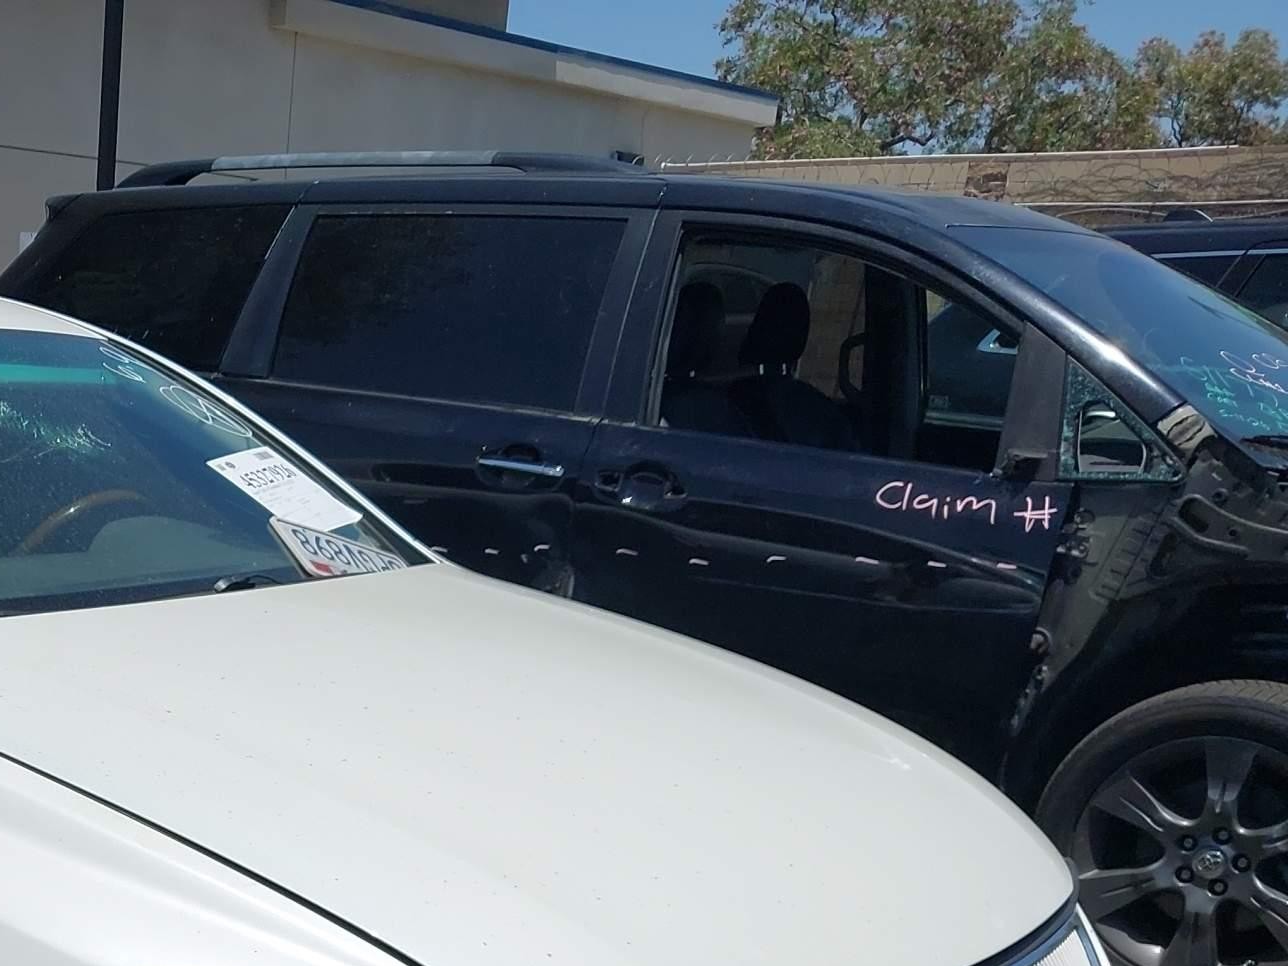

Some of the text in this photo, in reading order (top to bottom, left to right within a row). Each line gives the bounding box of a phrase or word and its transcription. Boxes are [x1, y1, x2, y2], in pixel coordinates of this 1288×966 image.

[239, 463, 297, 489] 45327926
[875, 481, 1058, 533] Claim #
